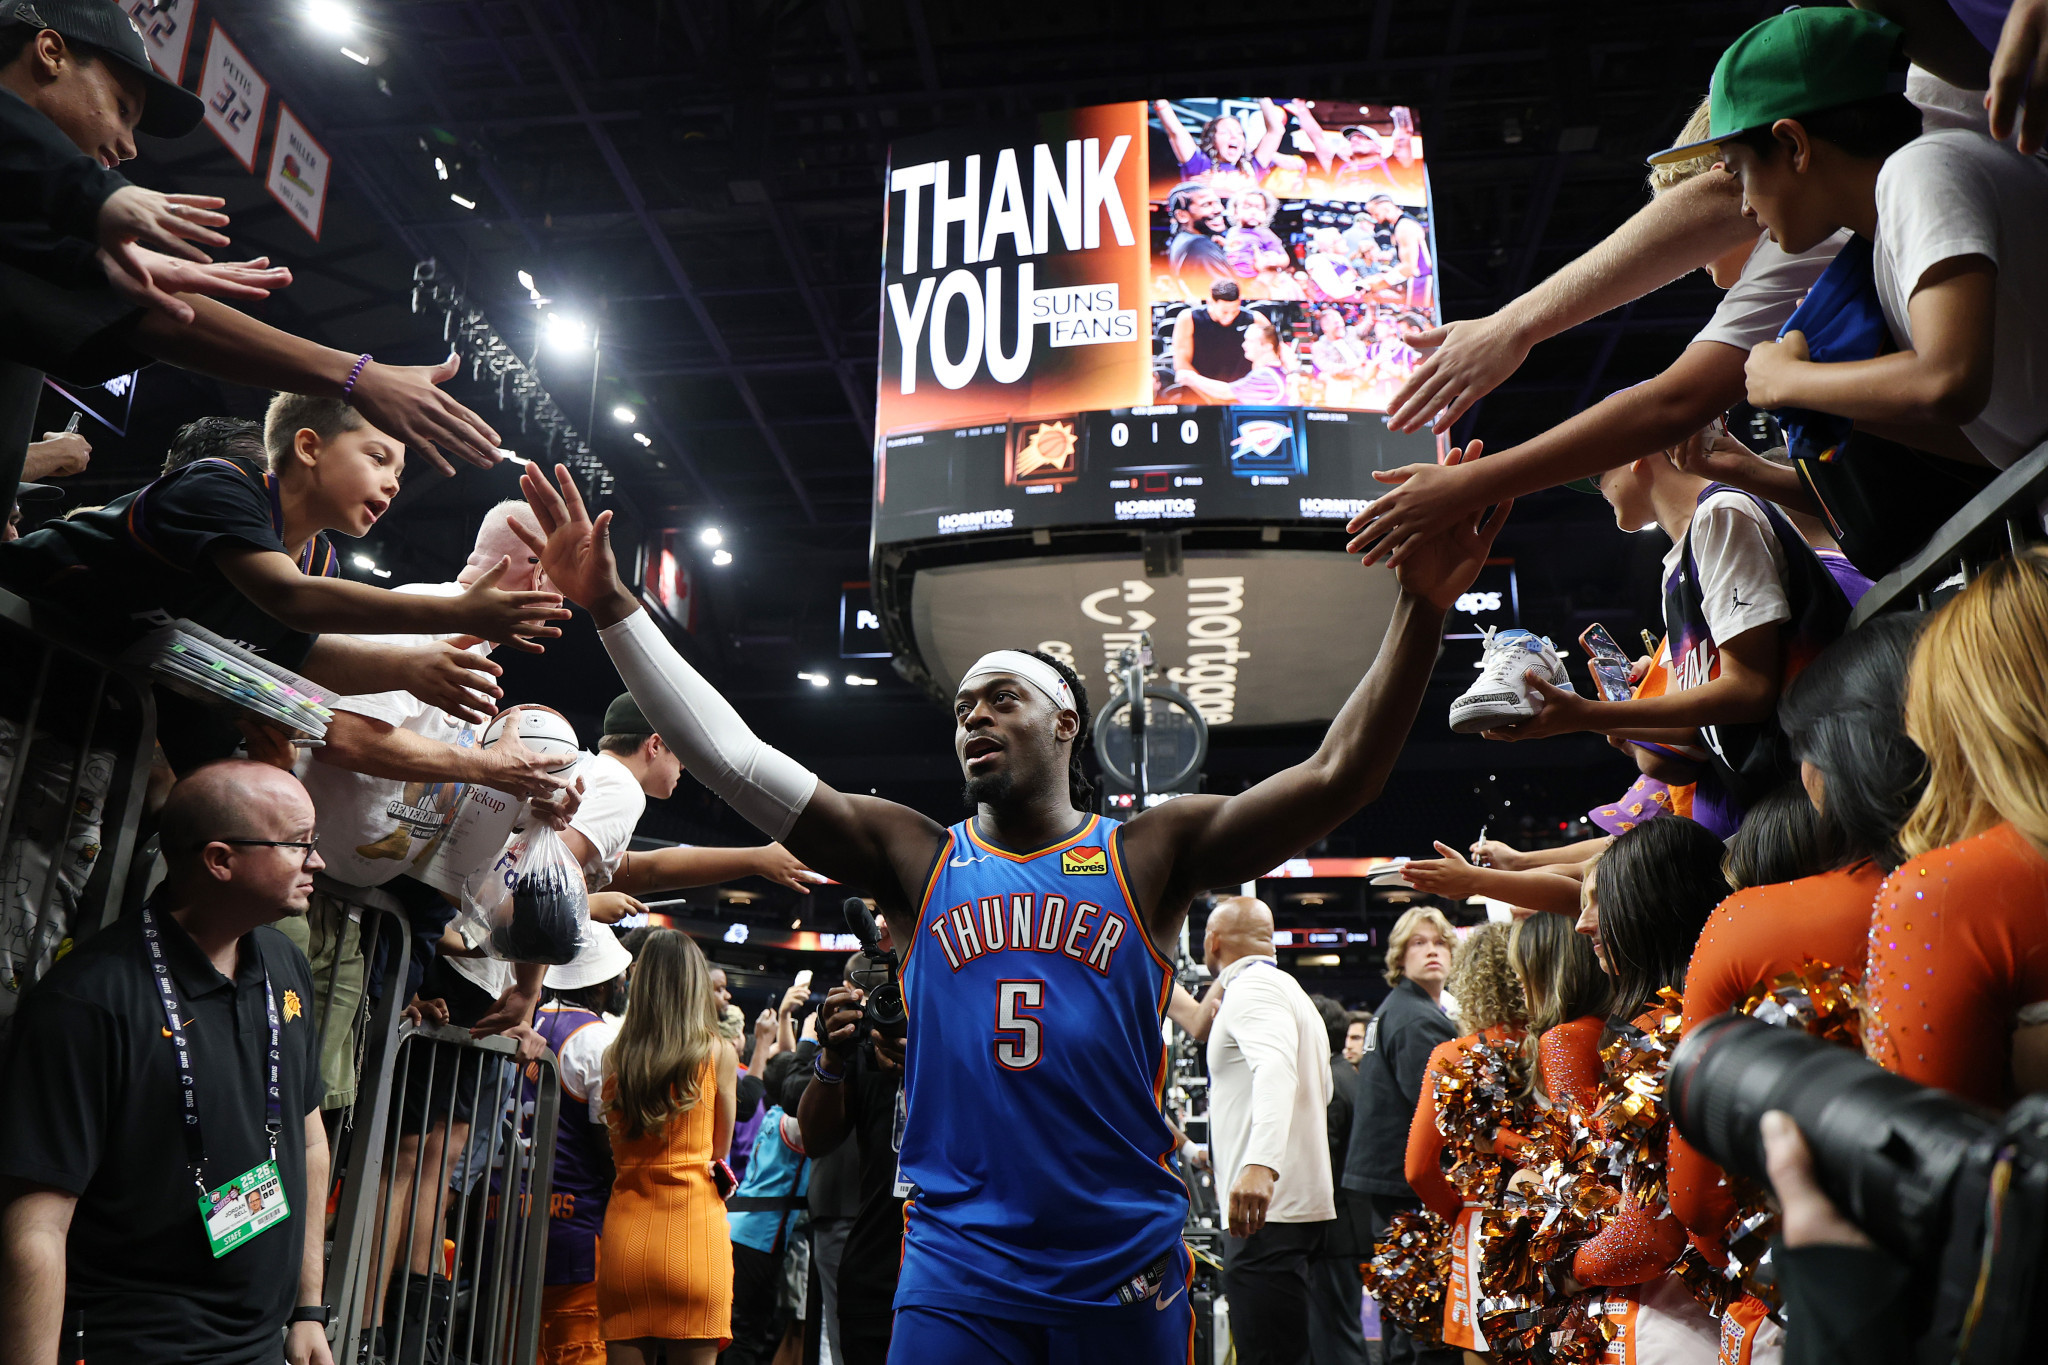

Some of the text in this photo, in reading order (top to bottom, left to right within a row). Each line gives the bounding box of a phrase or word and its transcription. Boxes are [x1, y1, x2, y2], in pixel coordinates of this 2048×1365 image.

[223, 56, 252, 97] PETTIS
[210, 78, 252, 135] 32
[289, 131, 317, 170] MILLER
[891, 135, 1136, 275] THANK
[1033, 290, 1114, 318] SUNS
[887, 262, 1034, 395] YOU
[1056, 315, 1132, 341] FANS
[1111, 423, 1129, 447] 0
[1180, 420, 1199, 444] 0
[938, 509, 1014, 529] HORNITOS
[1115, 498, 1196, 514] HORNITOS
[464, 786, 506, 813] Pickup
[929, 893, 1127, 976] THUNDER
[994, 979, 1044, 1071] 5
[240, 1163, 270, 1188] 25-26
[225, 1203, 246, 1218] JORDAN
[234, 1209, 248, 1218] BELL
[223, 1229, 242, 1246] STAFF
